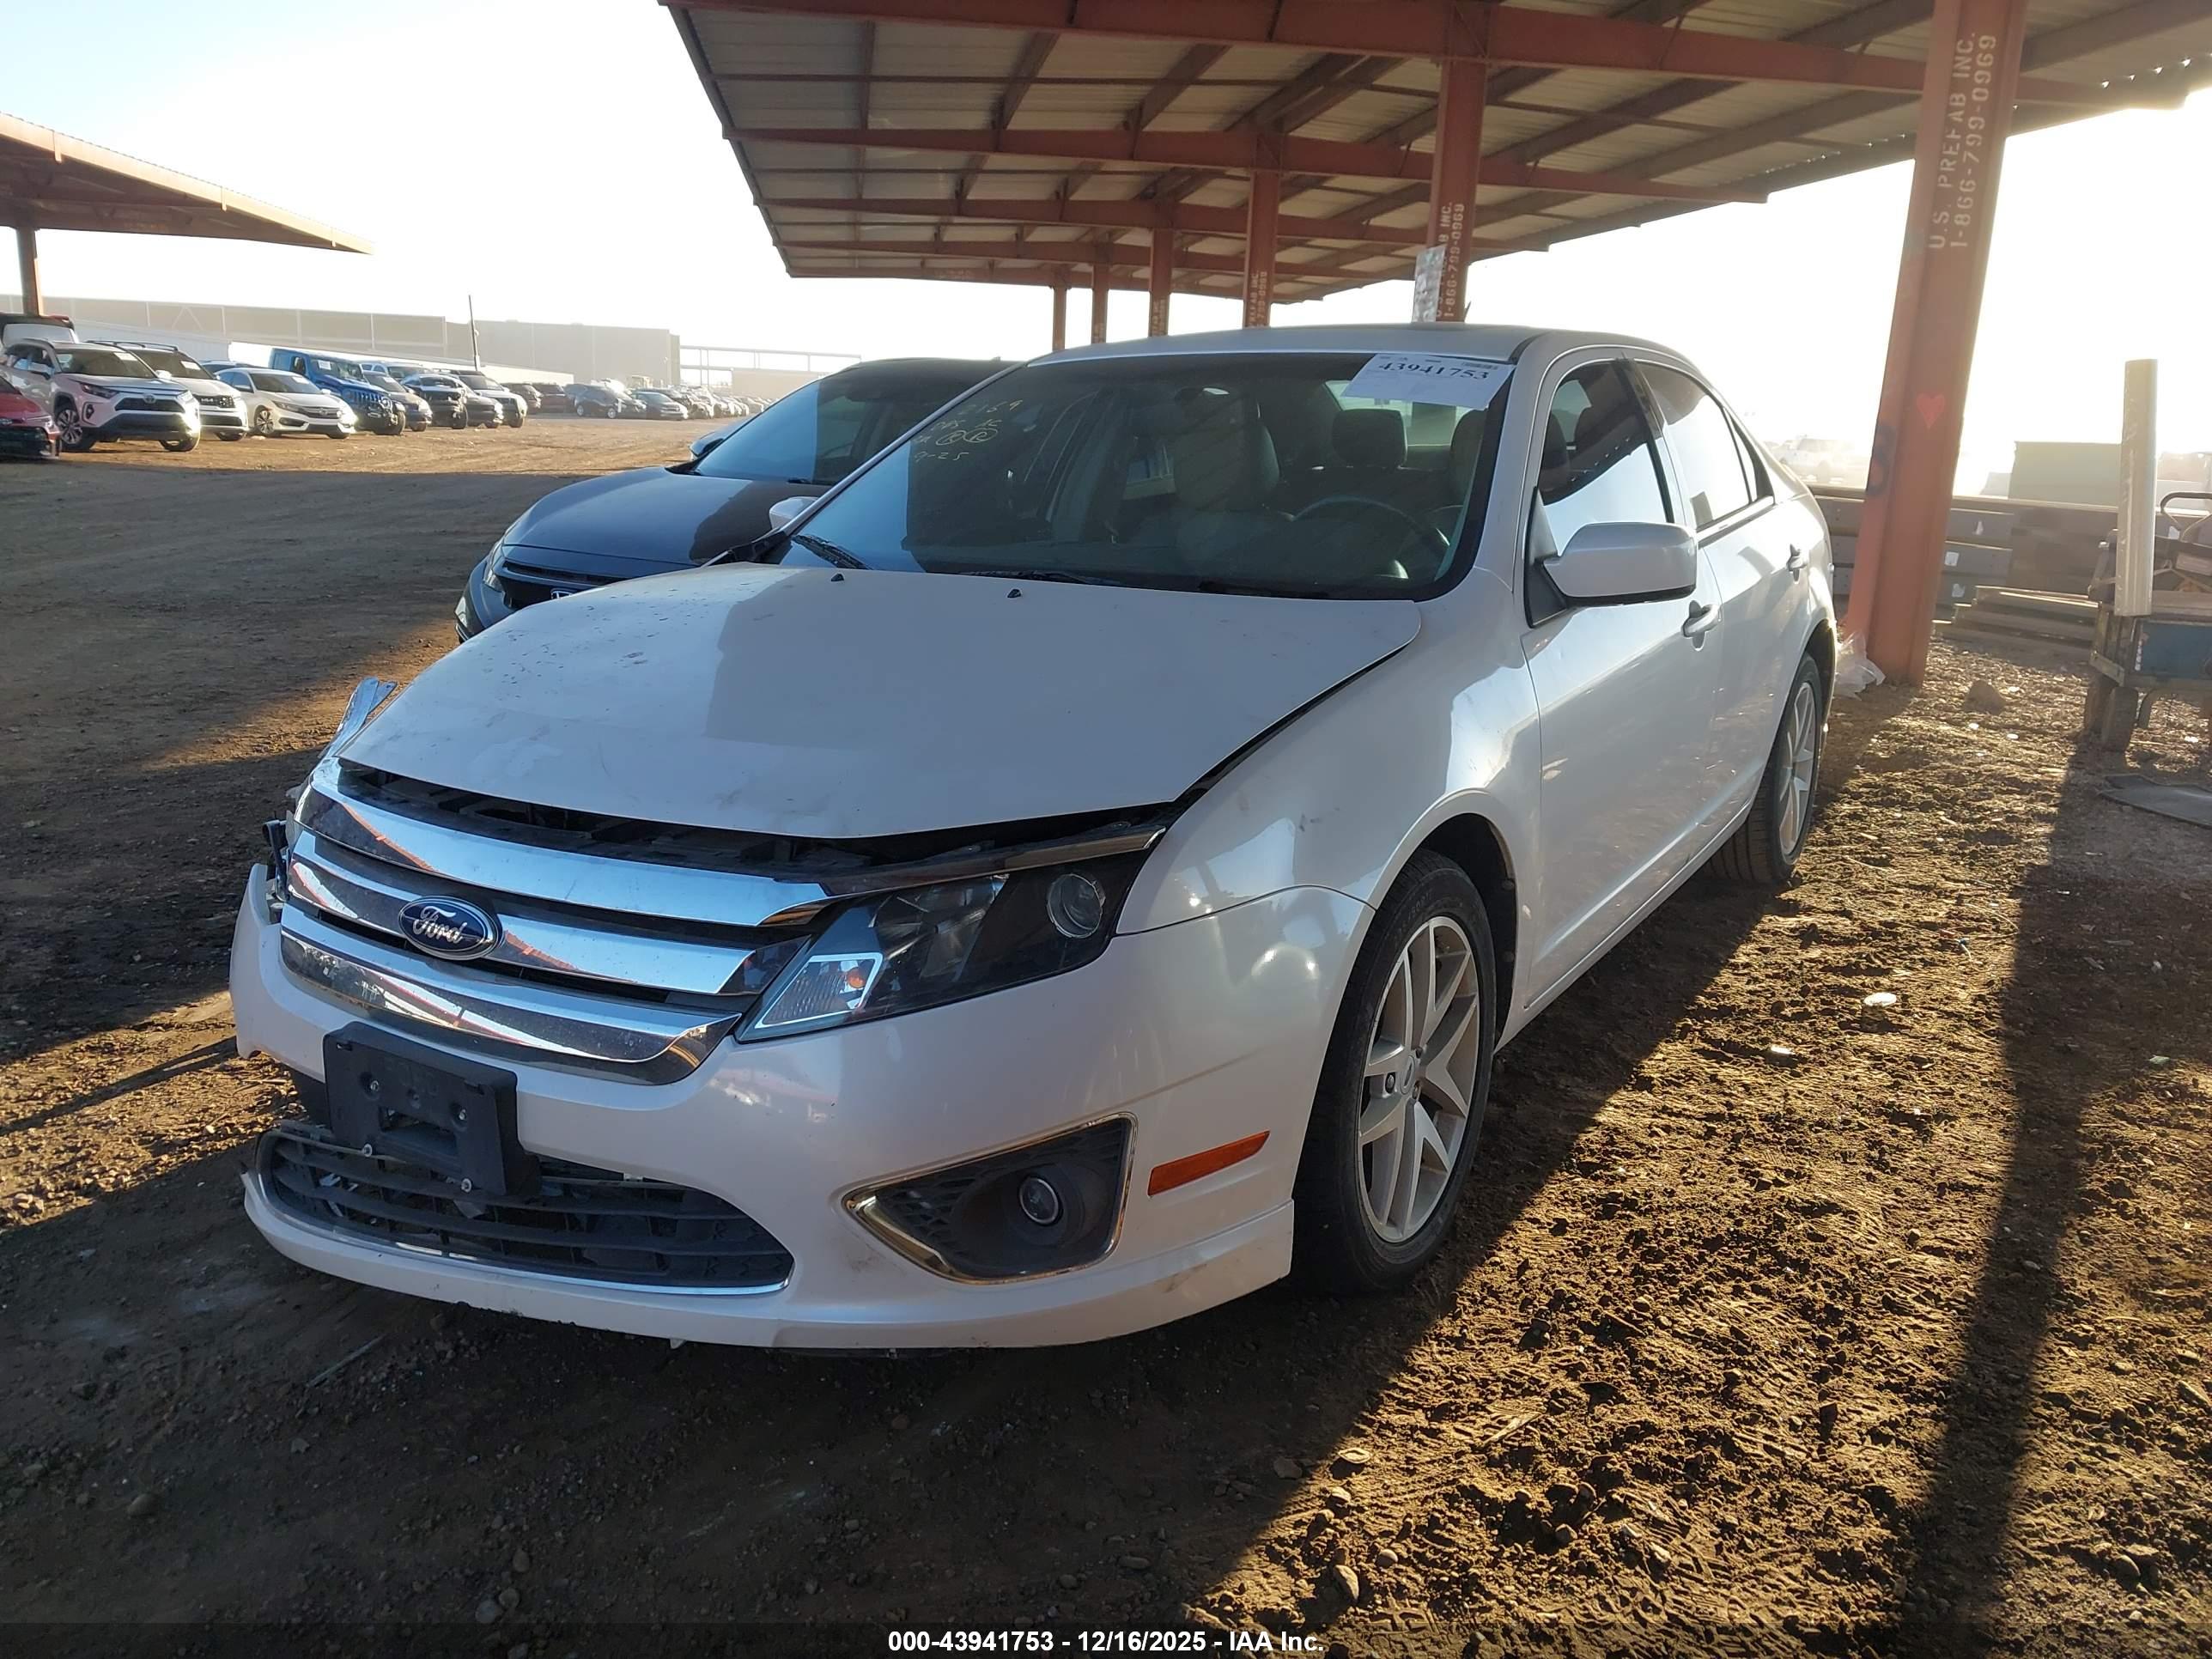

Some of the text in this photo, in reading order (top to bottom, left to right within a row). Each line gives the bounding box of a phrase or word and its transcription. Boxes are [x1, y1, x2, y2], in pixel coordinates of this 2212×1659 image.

[1937, 92, 1966, 187] PREFAB
[1953, 32, 1976, 78] INC.
[1950, 34, 1997, 248] 1-866-799-0969
[1377, 362, 1490, 380] 43941753
[412, 906, 468, 944] Ford
